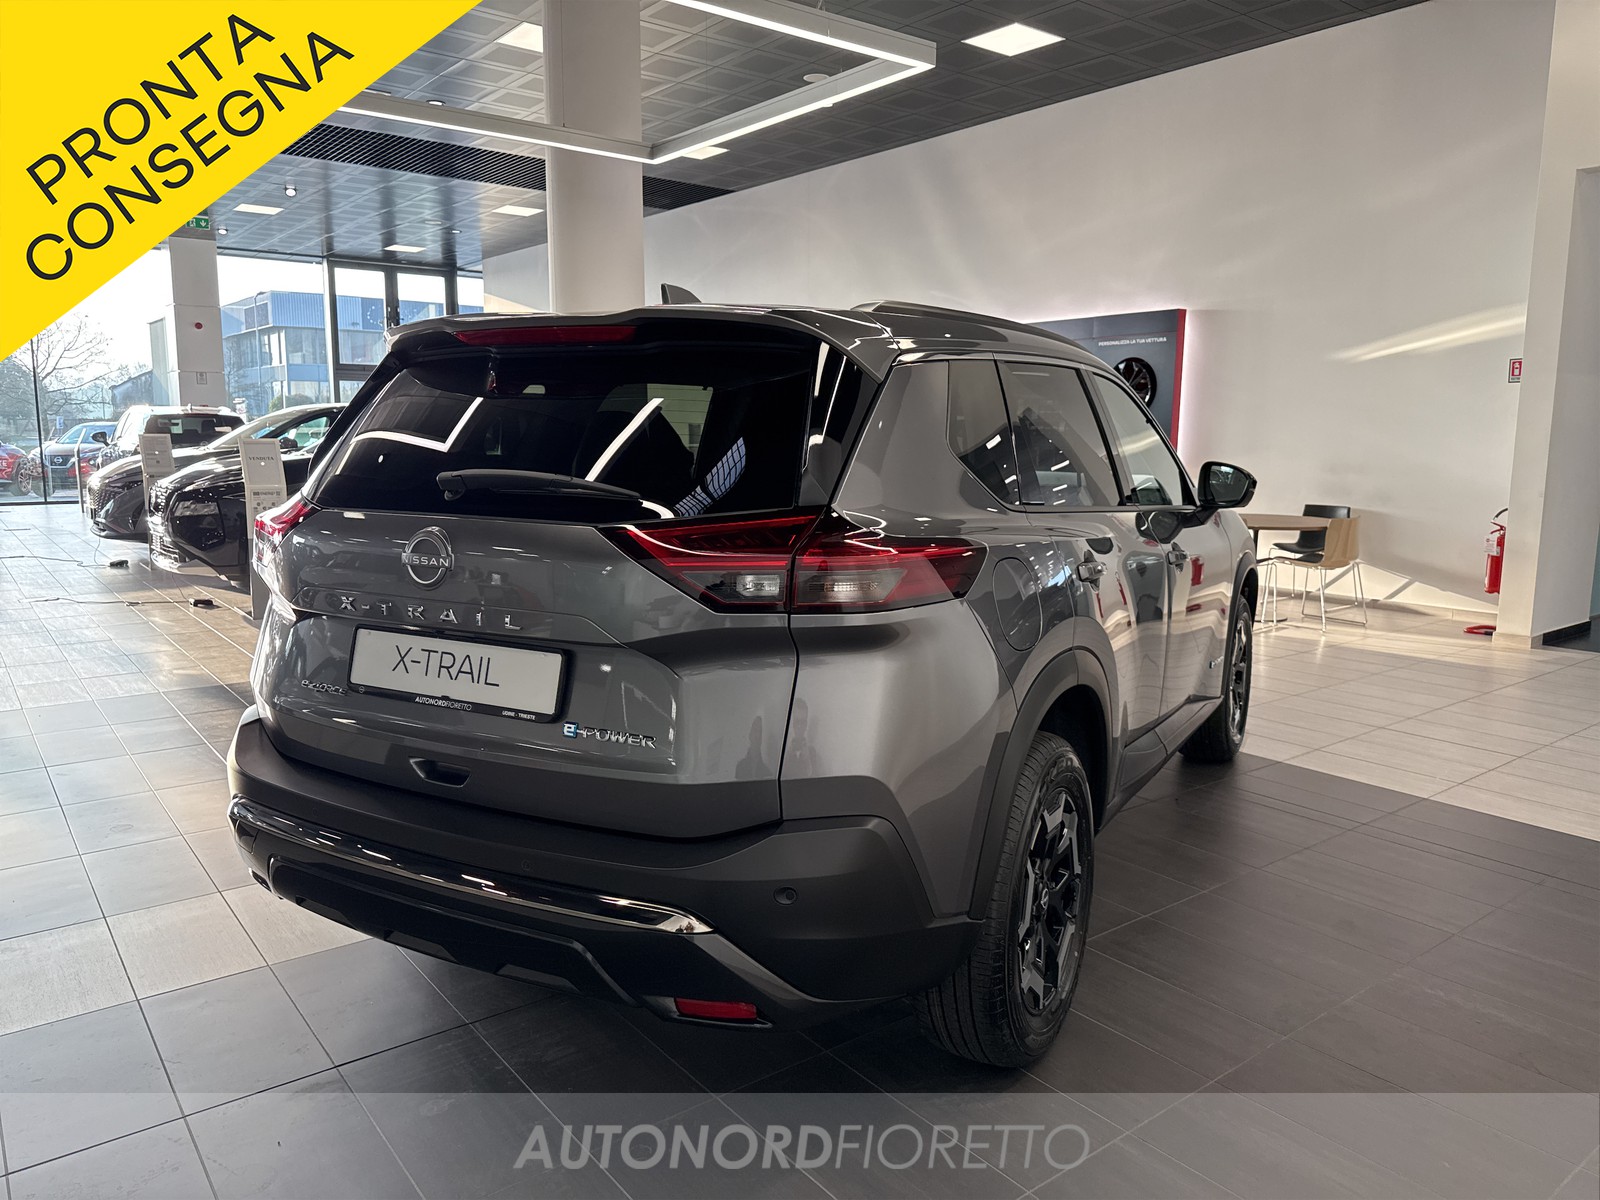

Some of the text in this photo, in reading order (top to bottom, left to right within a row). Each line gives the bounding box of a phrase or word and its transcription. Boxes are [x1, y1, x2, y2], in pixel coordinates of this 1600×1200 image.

[402, 553, 450, 567] NISSAN
[339, 595, 523, 630] X-TRAIL
[392, 644, 500, 688] X-TRAIL
[415, 696, 472, 711] AUTONORDFIORETTO
